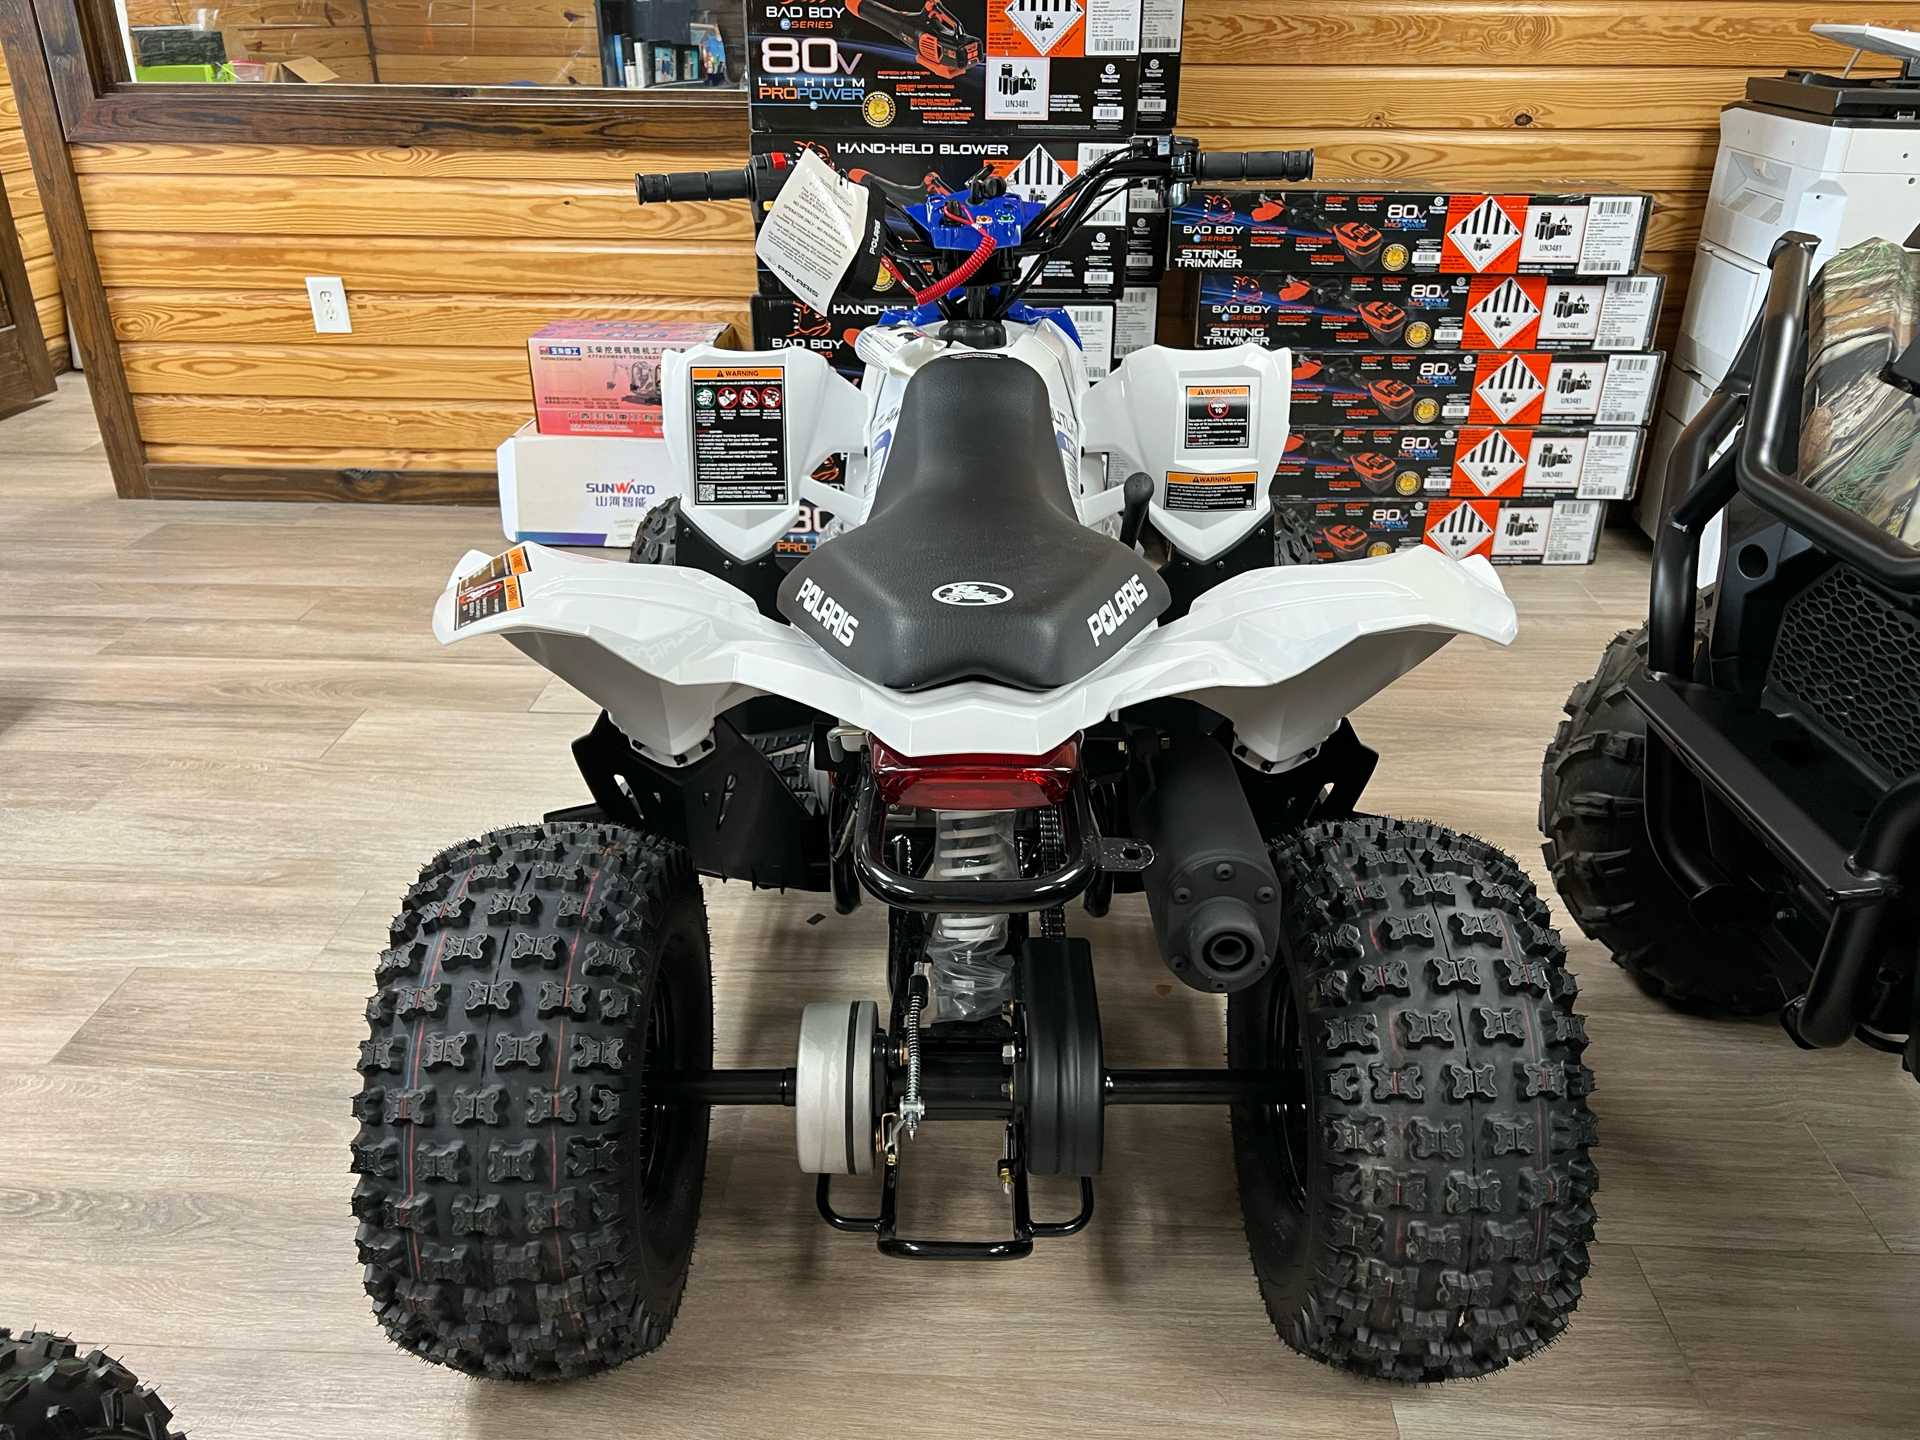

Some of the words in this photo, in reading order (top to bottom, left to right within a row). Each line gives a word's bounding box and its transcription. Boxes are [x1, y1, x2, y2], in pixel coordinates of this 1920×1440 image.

[766, 6, 803, 18] BAD
[809, 7, 845, 18] BOY
[791, 20, 833, 29] SERIES
[758, 77, 865, 88] LITHIUM
[759, 87, 865, 100] PROPOWER
[1005, 100, 1029, 108] UN3481
[836, 142, 934, 154] HAND-HELD
[939, 144, 1009, 155] BLOWER
[782, 203, 804, 219] OPERATOR
[803, 217, 814, 226] ONLY
[798, 204, 820, 220] OPERATOR
[1183, 226, 1212, 234] BAD
[1215, 226, 1244, 235] BOY
[869, 219, 881, 255] POLARIS
[1539, 244, 1562, 252] UN3481
[1181, 249, 1237, 259] STRING
[1175, 258, 1243, 268] TRIMMER
[777, 264, 820, 298] POLARIS
[1212, 305, 1240, 314] BAD
[1243, 305, 1271, 314] BOY
[1210, 328, 1265, 337] STRING
[772, 338, 806, 348] BAD
[810, 339, 844, 349] BOY
[1203, 336, 1270, 346] TRIMMER
[586, 478, 655, 495] SUNWARD
[596, 496, 647, 508] 山河智能
[795, 577, 859, 647] POLARIS
[1086, 573, 1149, 647] POLARIS
